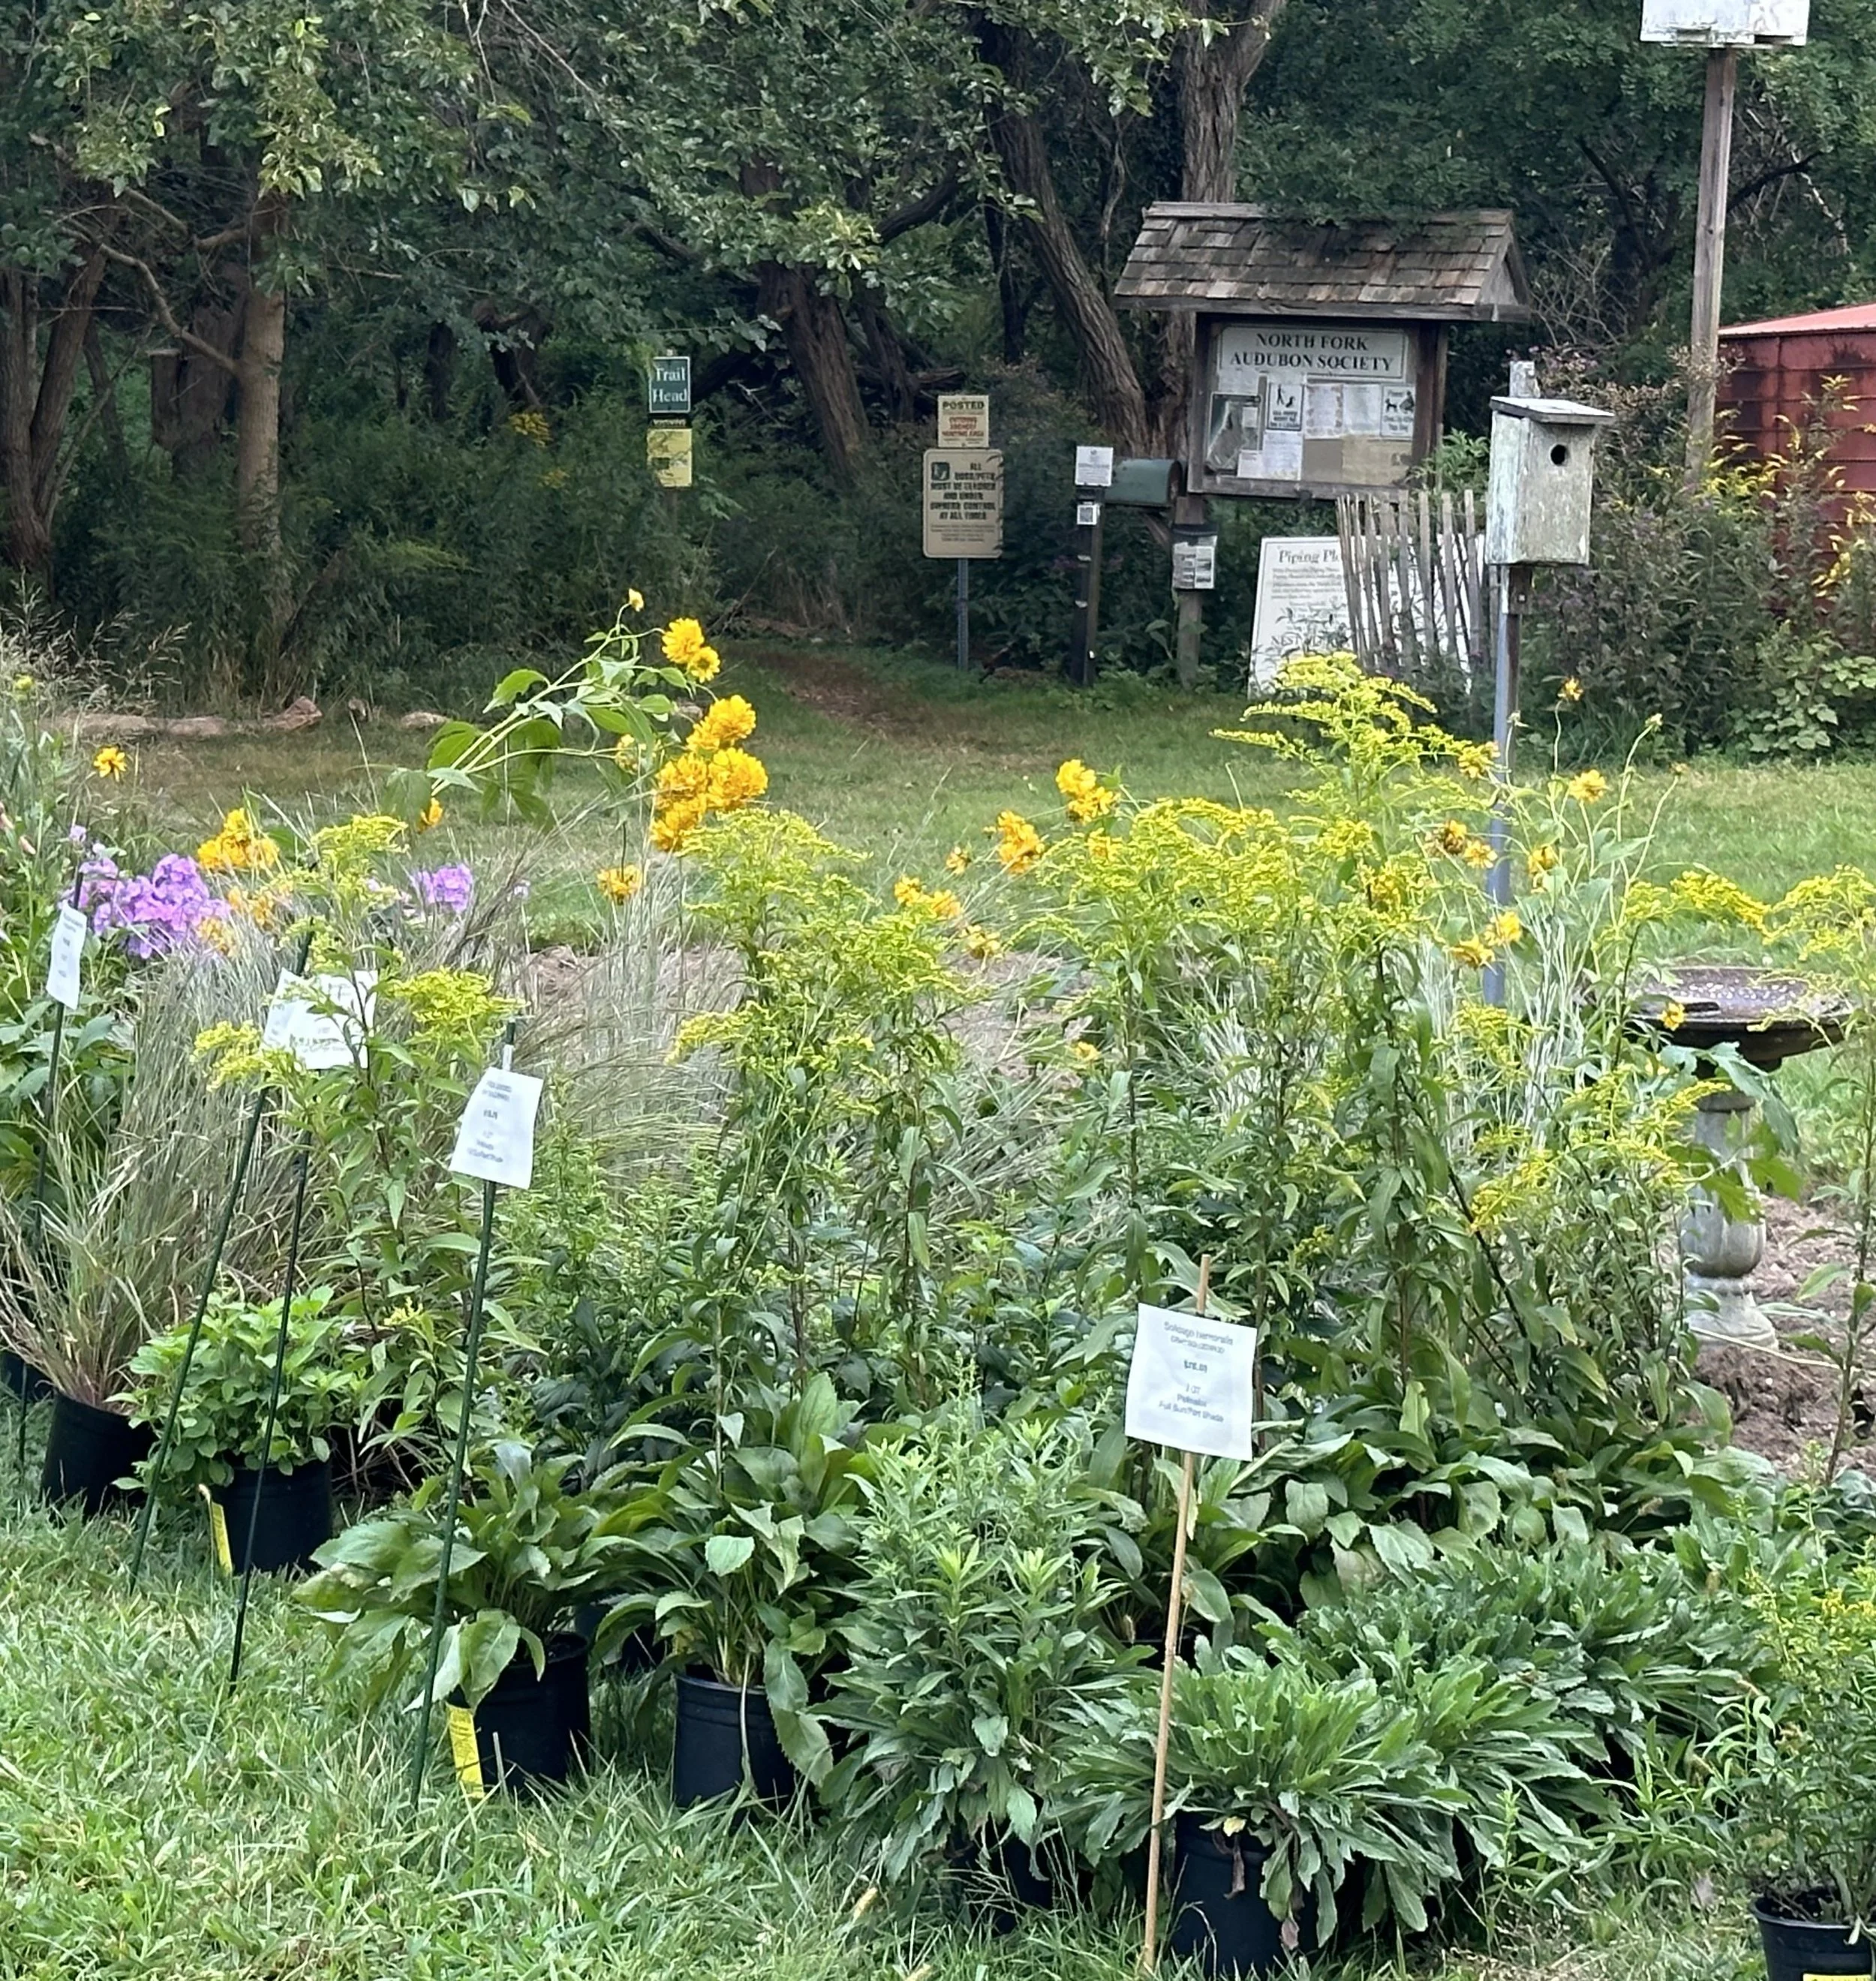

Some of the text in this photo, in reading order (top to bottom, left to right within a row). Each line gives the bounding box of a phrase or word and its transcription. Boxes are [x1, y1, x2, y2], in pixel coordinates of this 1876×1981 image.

[1256, 333, 1369, 350] NORTH FORK
[1231, 351, 1395, 371] AUDUBON SOCIETY
[656, 366, 686, 381] Trail
[652, 389, 688, 403] Head
[943, 401, 985, 410] POSTED
[970, 462, 982, 470] ALL
[1279, 549, 1320, 564] Piping
